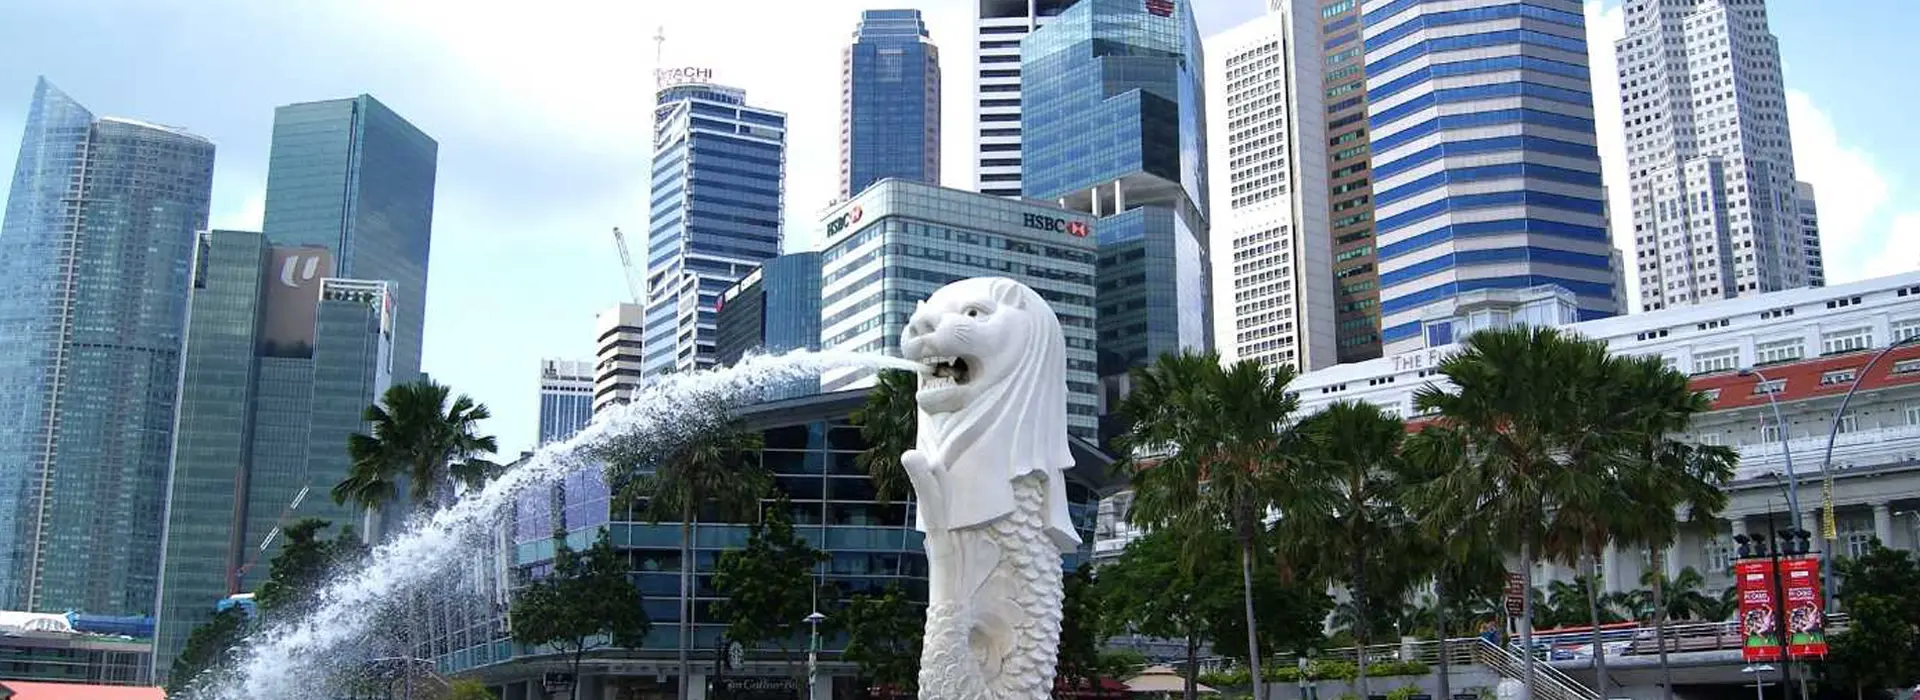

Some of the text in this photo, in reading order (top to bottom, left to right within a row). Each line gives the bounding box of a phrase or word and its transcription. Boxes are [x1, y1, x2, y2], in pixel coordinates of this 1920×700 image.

[827, 212, 850, 238] HSBC
[1023, 212, 1066, 233] HSBC
[1392, 354, 1422, 371] THE
